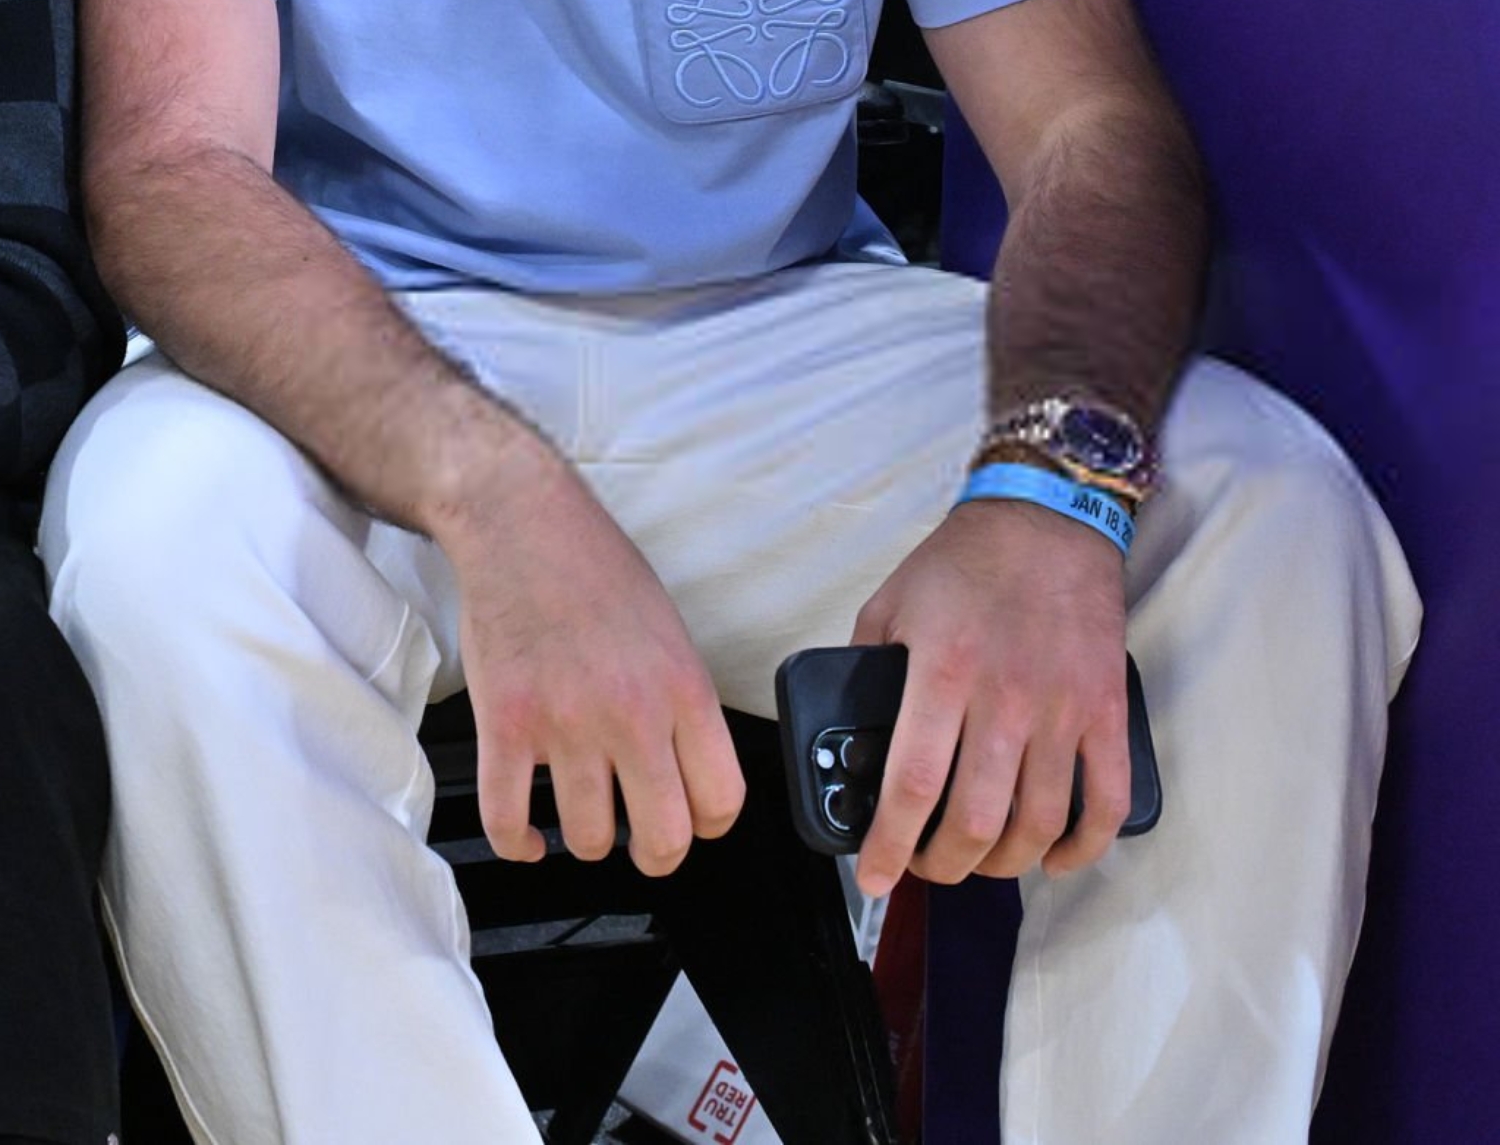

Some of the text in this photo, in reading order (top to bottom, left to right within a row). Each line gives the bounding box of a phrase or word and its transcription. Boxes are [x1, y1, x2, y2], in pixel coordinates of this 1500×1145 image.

[1070, 493, 1103, 519] JAN
[715, 1081, 749, 1109] RED
[702, 1097, 739, 1127] TRU
